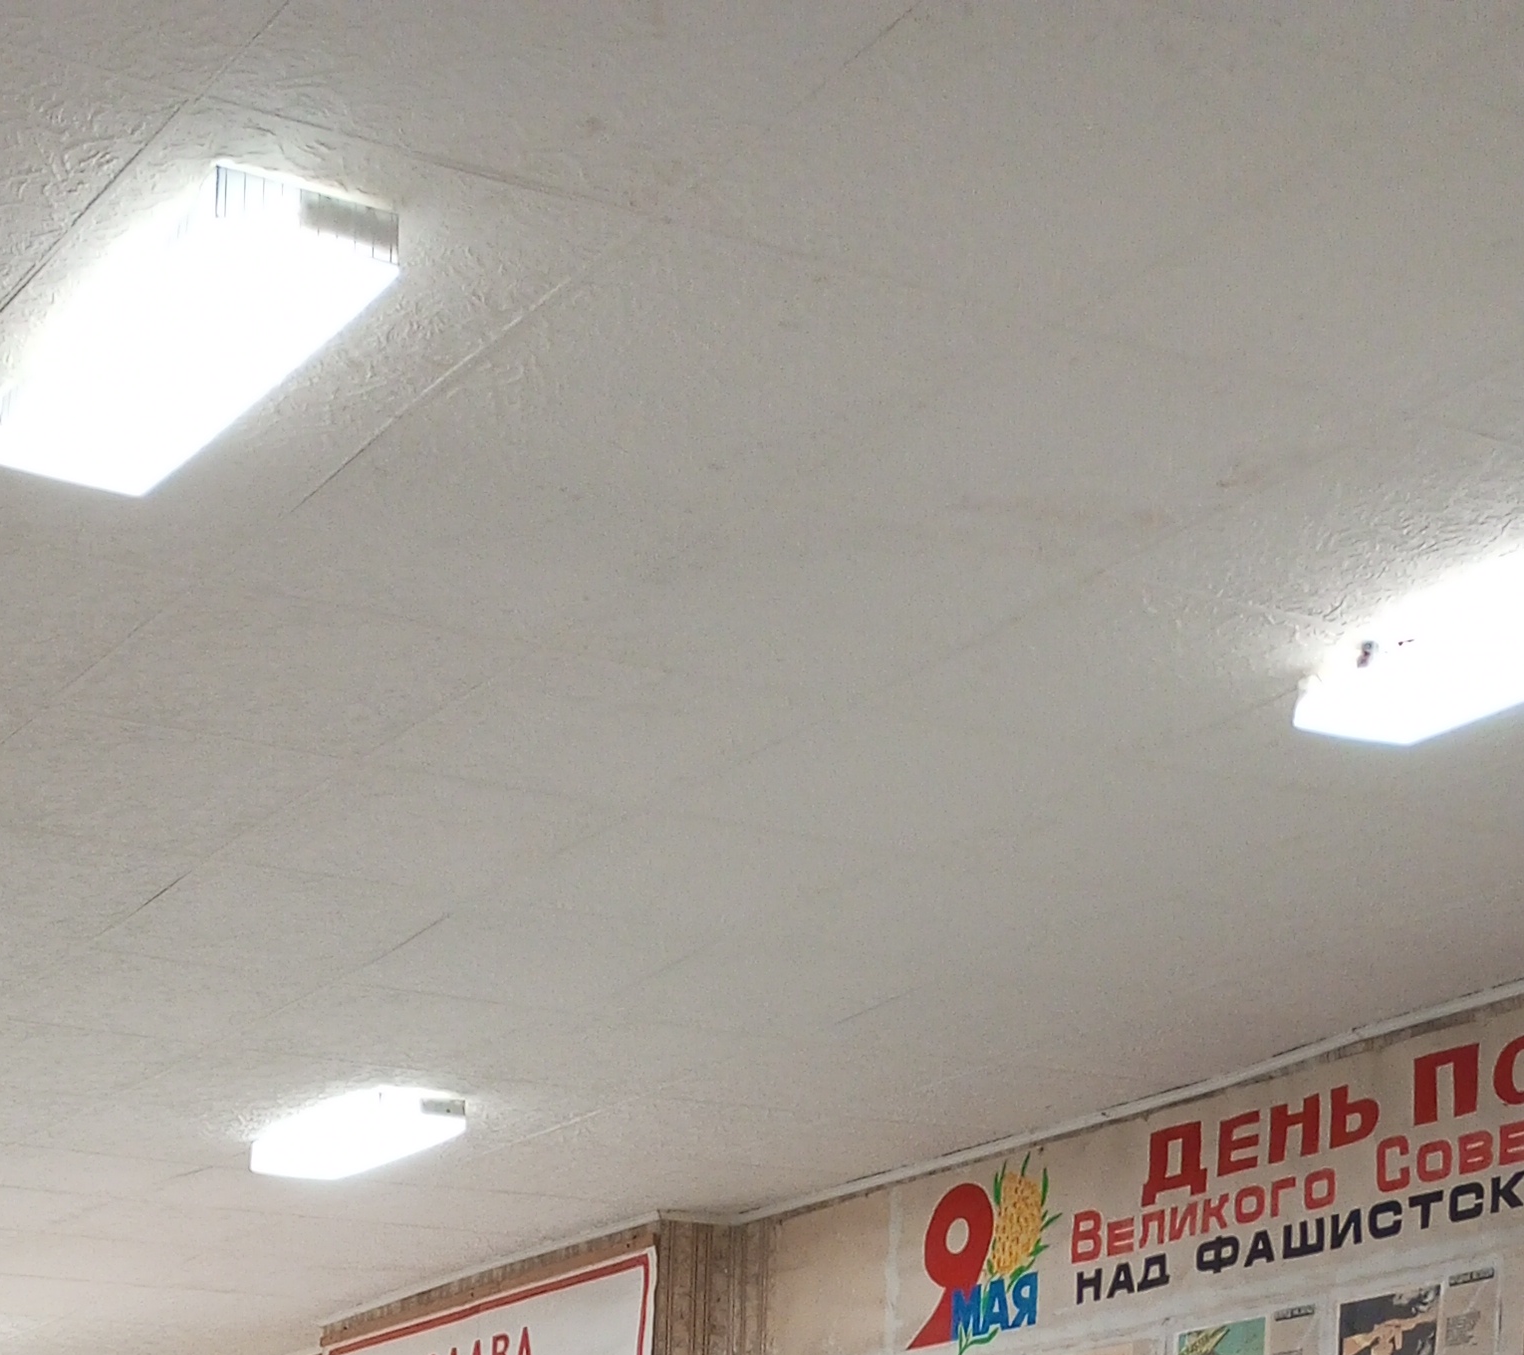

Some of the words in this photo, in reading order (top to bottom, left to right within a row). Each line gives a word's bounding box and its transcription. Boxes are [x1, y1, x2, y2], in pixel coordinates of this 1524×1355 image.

[1140, 1083, 1381, 1208] ДЕНЬ
[905, 1181, 995, 1351] 9
[1075, 1252, 1171, 1306] НАД
[1195, 1170, 1524, 1274] ФАШИСТСК
[950, 1271, 1039, 1342] МАЯ
